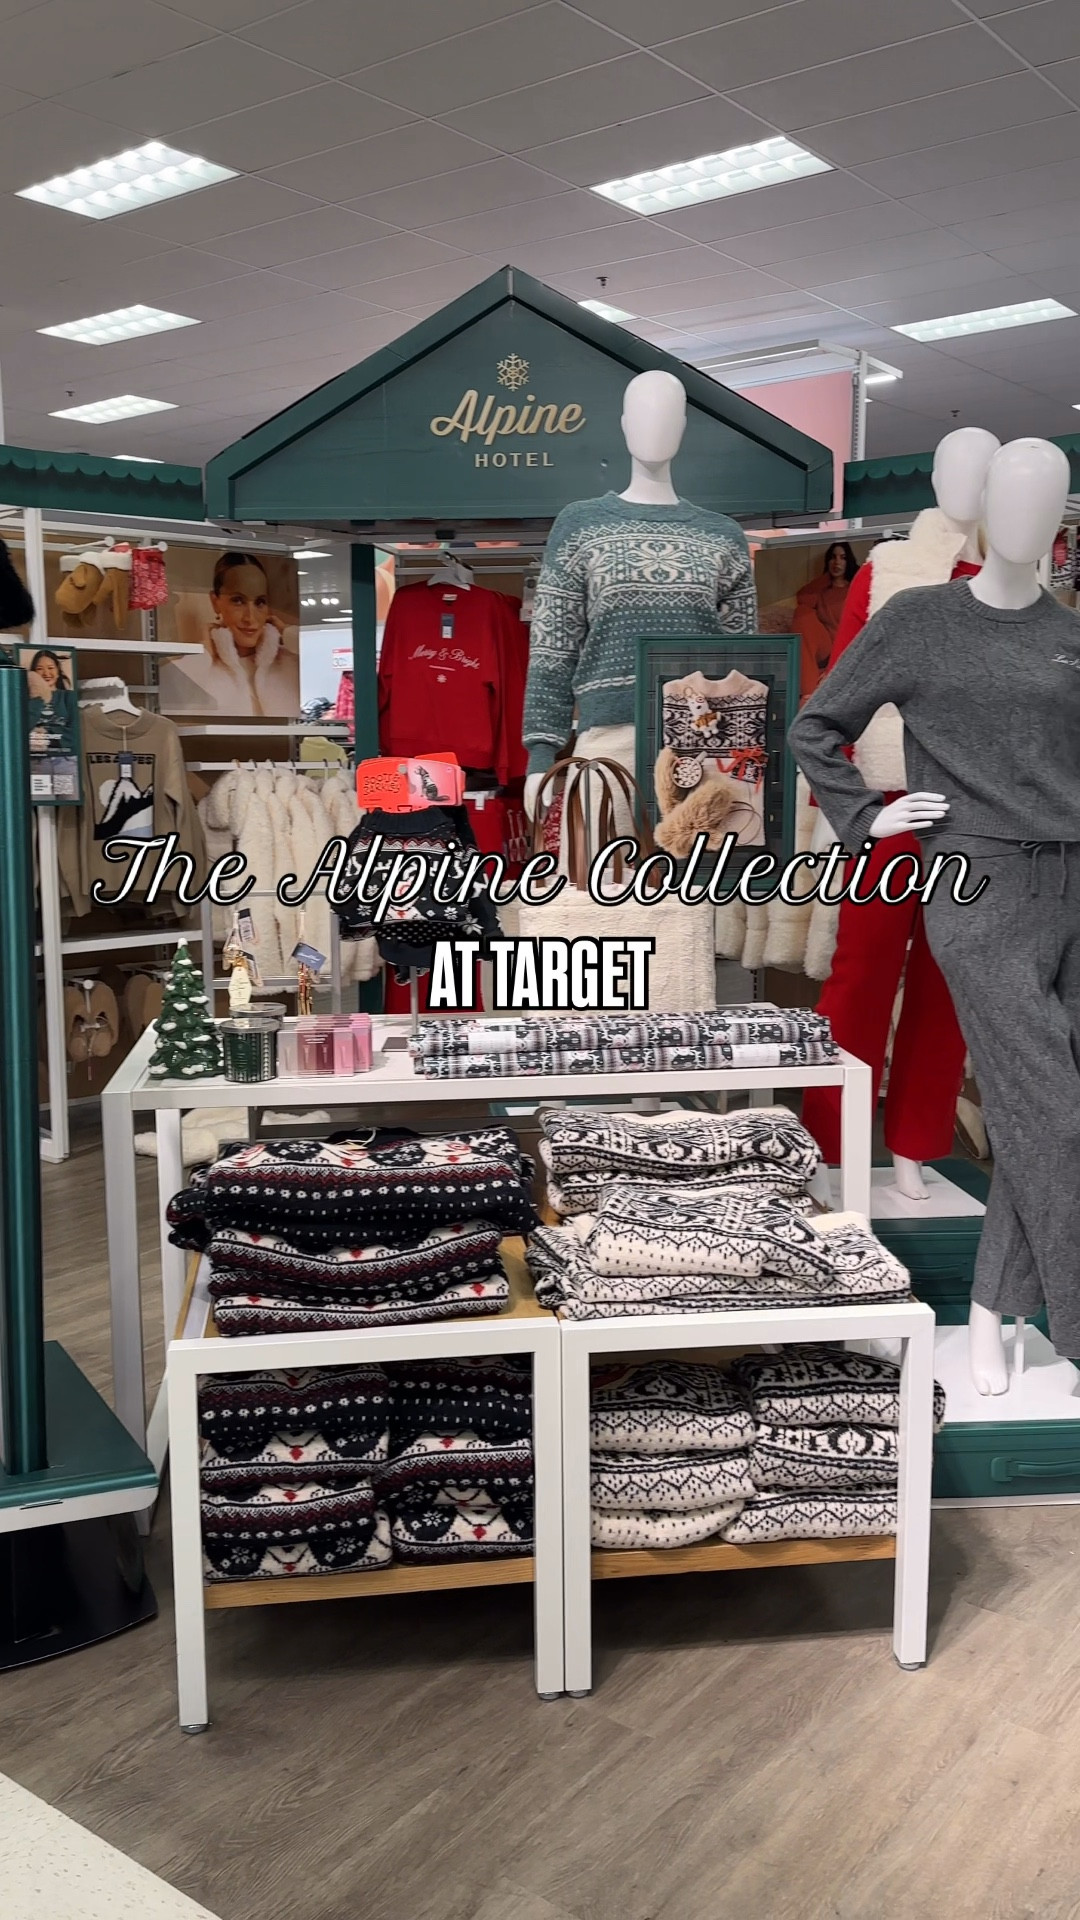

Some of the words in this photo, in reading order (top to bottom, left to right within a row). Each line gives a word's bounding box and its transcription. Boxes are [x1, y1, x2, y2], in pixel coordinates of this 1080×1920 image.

[430, 389, 586, 445] Alpine
[475, 452, 555, 468] HOTEL
[438, 648, 449, 660] &
[448, 648, 480, 669] Bright
[89, 755, 111, 764] LES
[113, 755, 152, 765] APES
